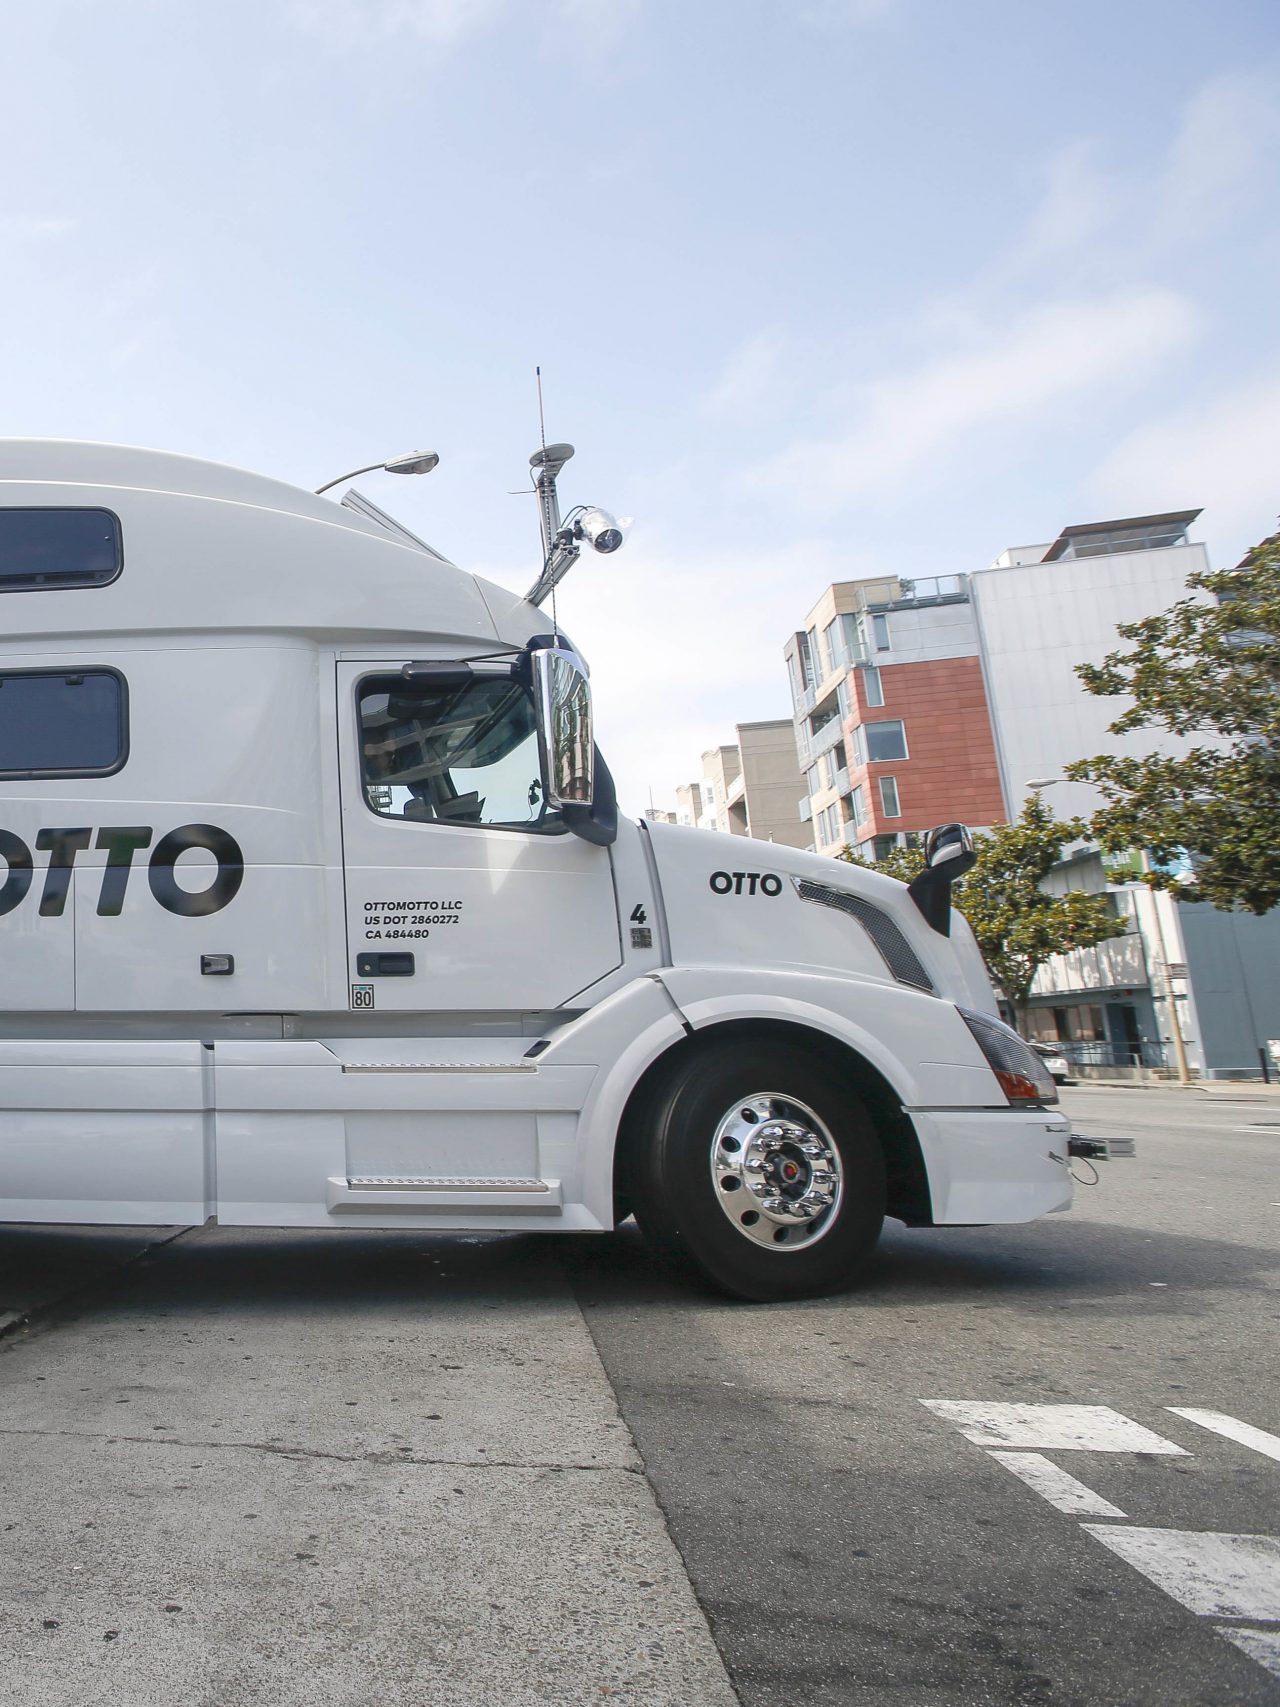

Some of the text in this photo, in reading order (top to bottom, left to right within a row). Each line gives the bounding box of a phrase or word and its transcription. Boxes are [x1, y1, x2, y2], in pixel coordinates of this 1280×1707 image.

[709, 870, 783, 897] OTTO
[363, 901, 463, 911] OTTOMOTTO LLC
[630, 903, 647, 924] 4
[364, 915, 459, 925] US DOT 2860272
[365, 929, 429, 939] CA 484480
[355, 991, 371, 1006] 80
